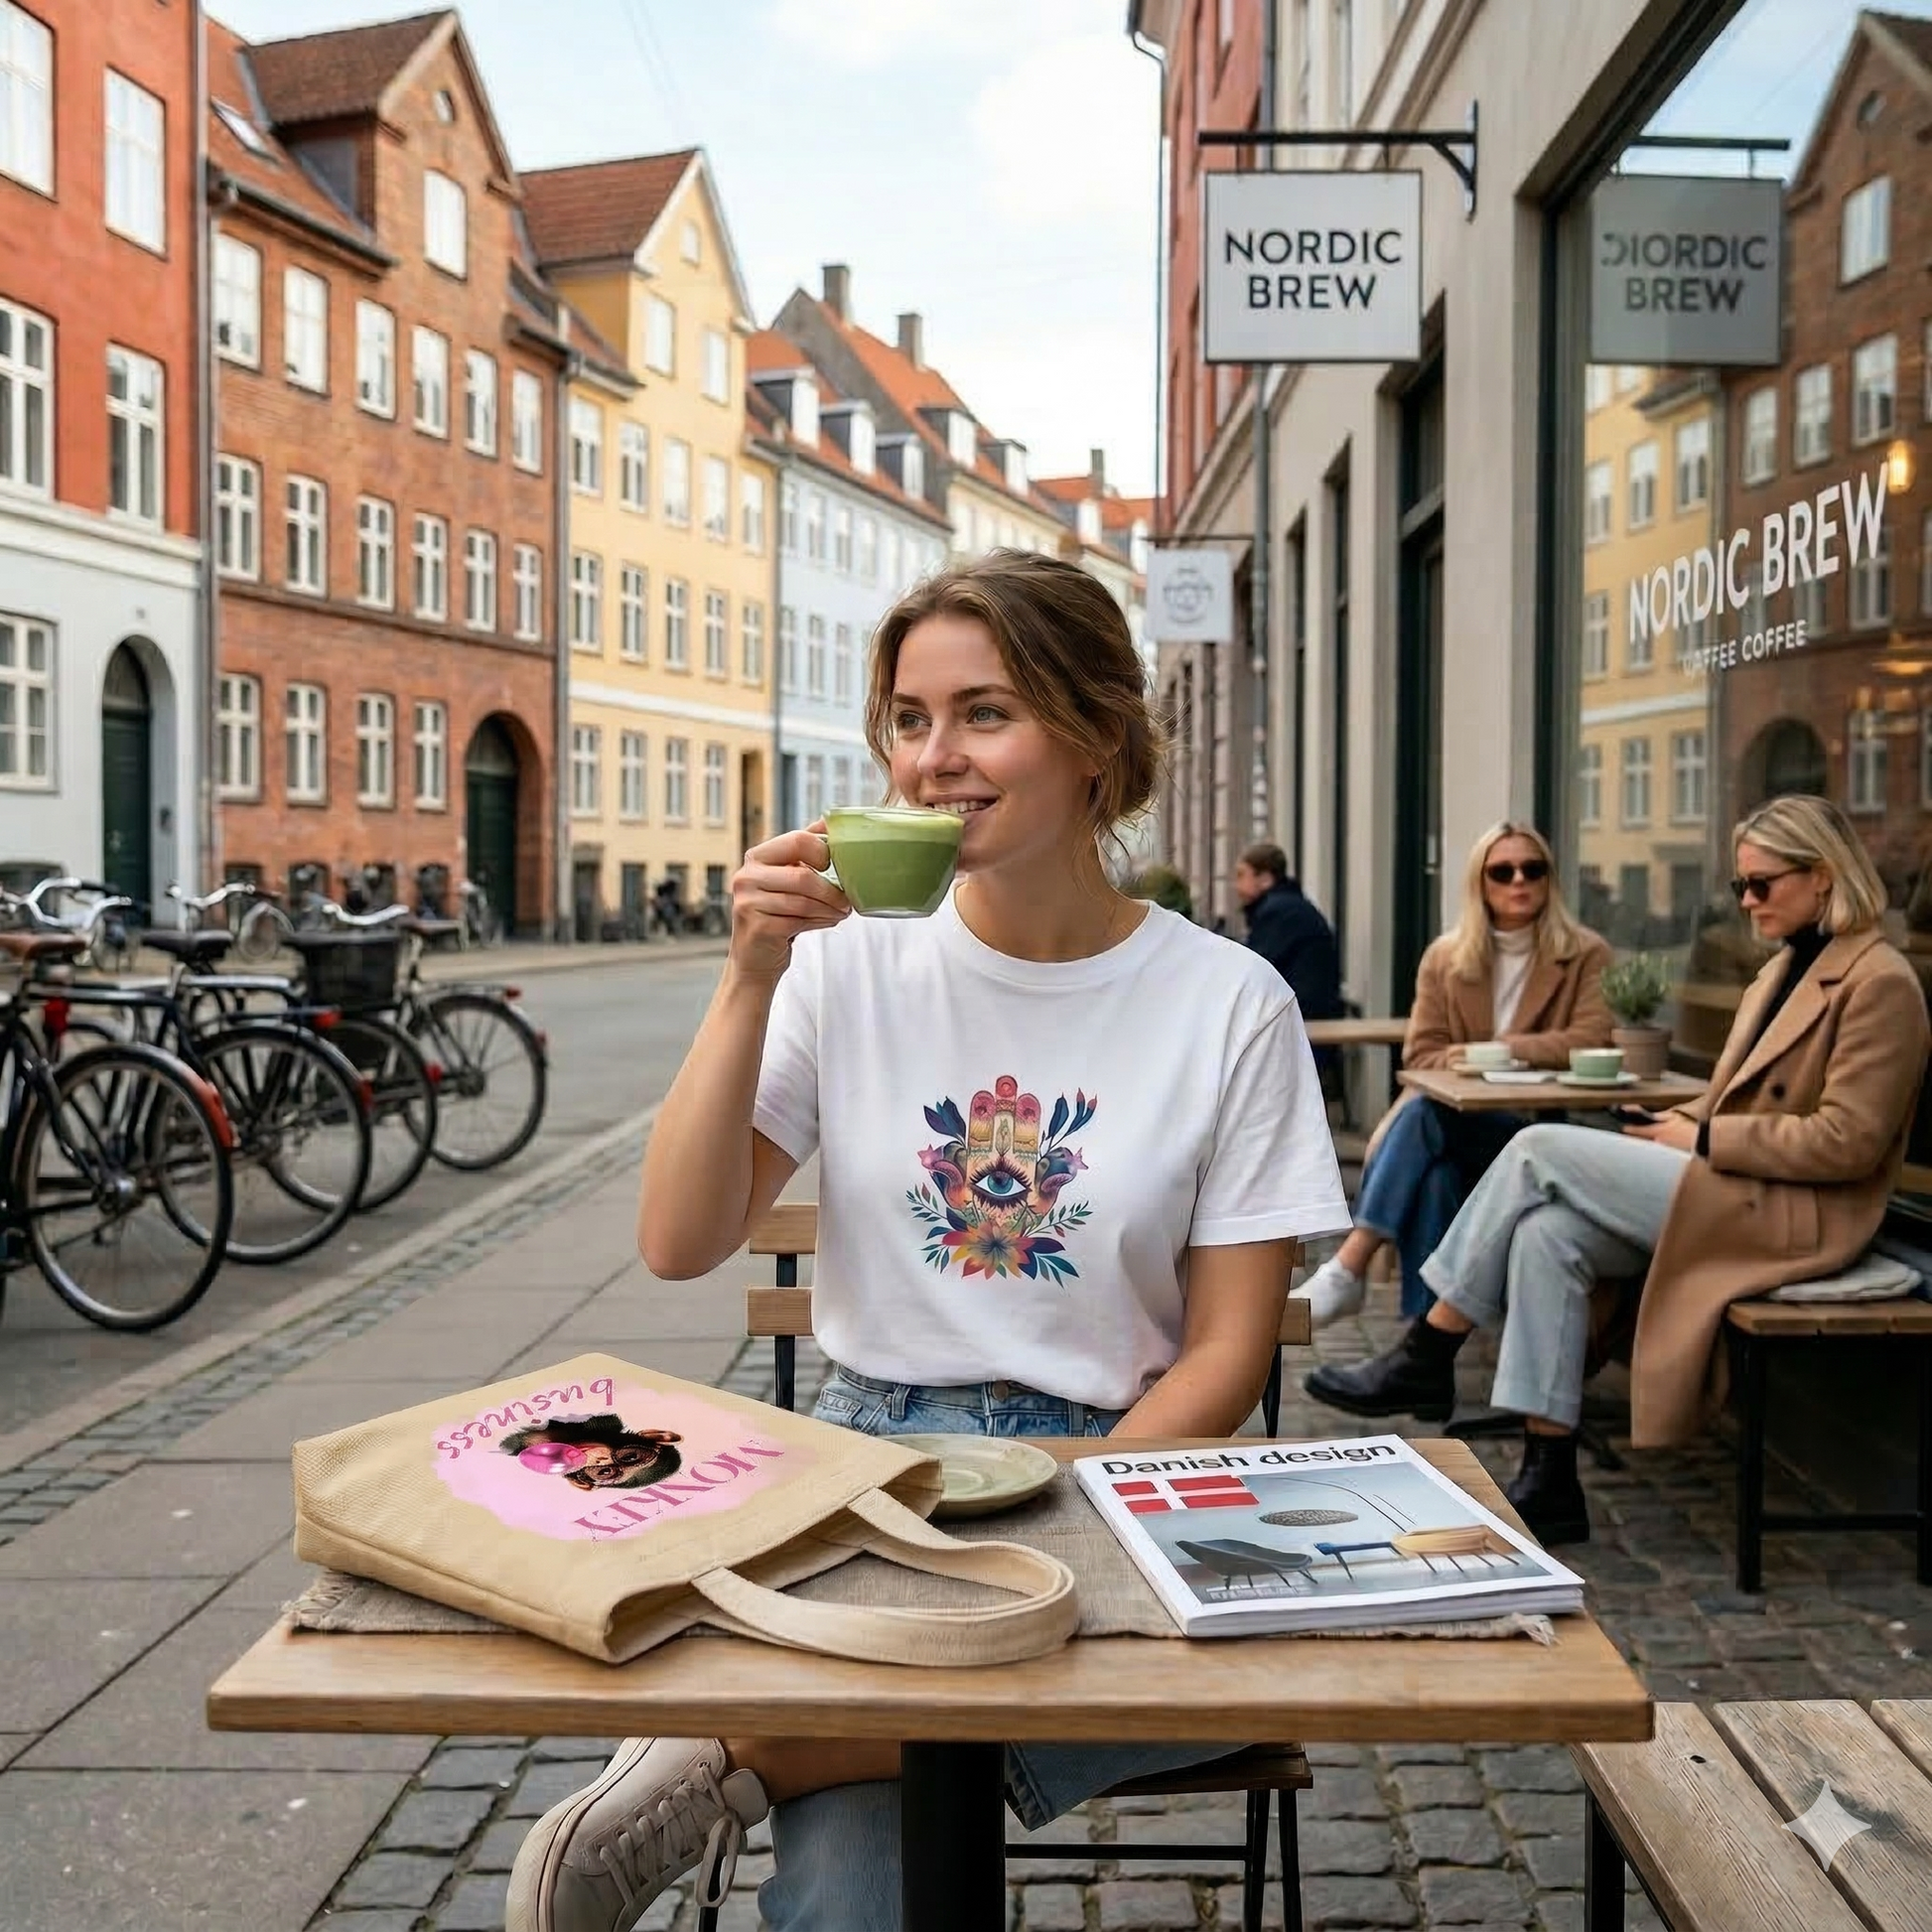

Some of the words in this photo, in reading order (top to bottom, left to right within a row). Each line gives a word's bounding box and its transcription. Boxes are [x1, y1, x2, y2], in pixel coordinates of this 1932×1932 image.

[1224, 229, 1402, 264] NORDIC
[1248, 274, 1376, 309] BREW
[1625, 276, 1744, 313] BREW
[1629, 527, 1750, 645] NORDIC
[1761, 461, 1888, 598] BREW
[1741, 619, 1808, 662] COFFEE
[436, 1376, 616, 1460] business
[1101, 1453, 1249, 1475] Danish
[1259, 1444, 1396, 1463] design
[573, 1439, 785, 1542] MONKEY
